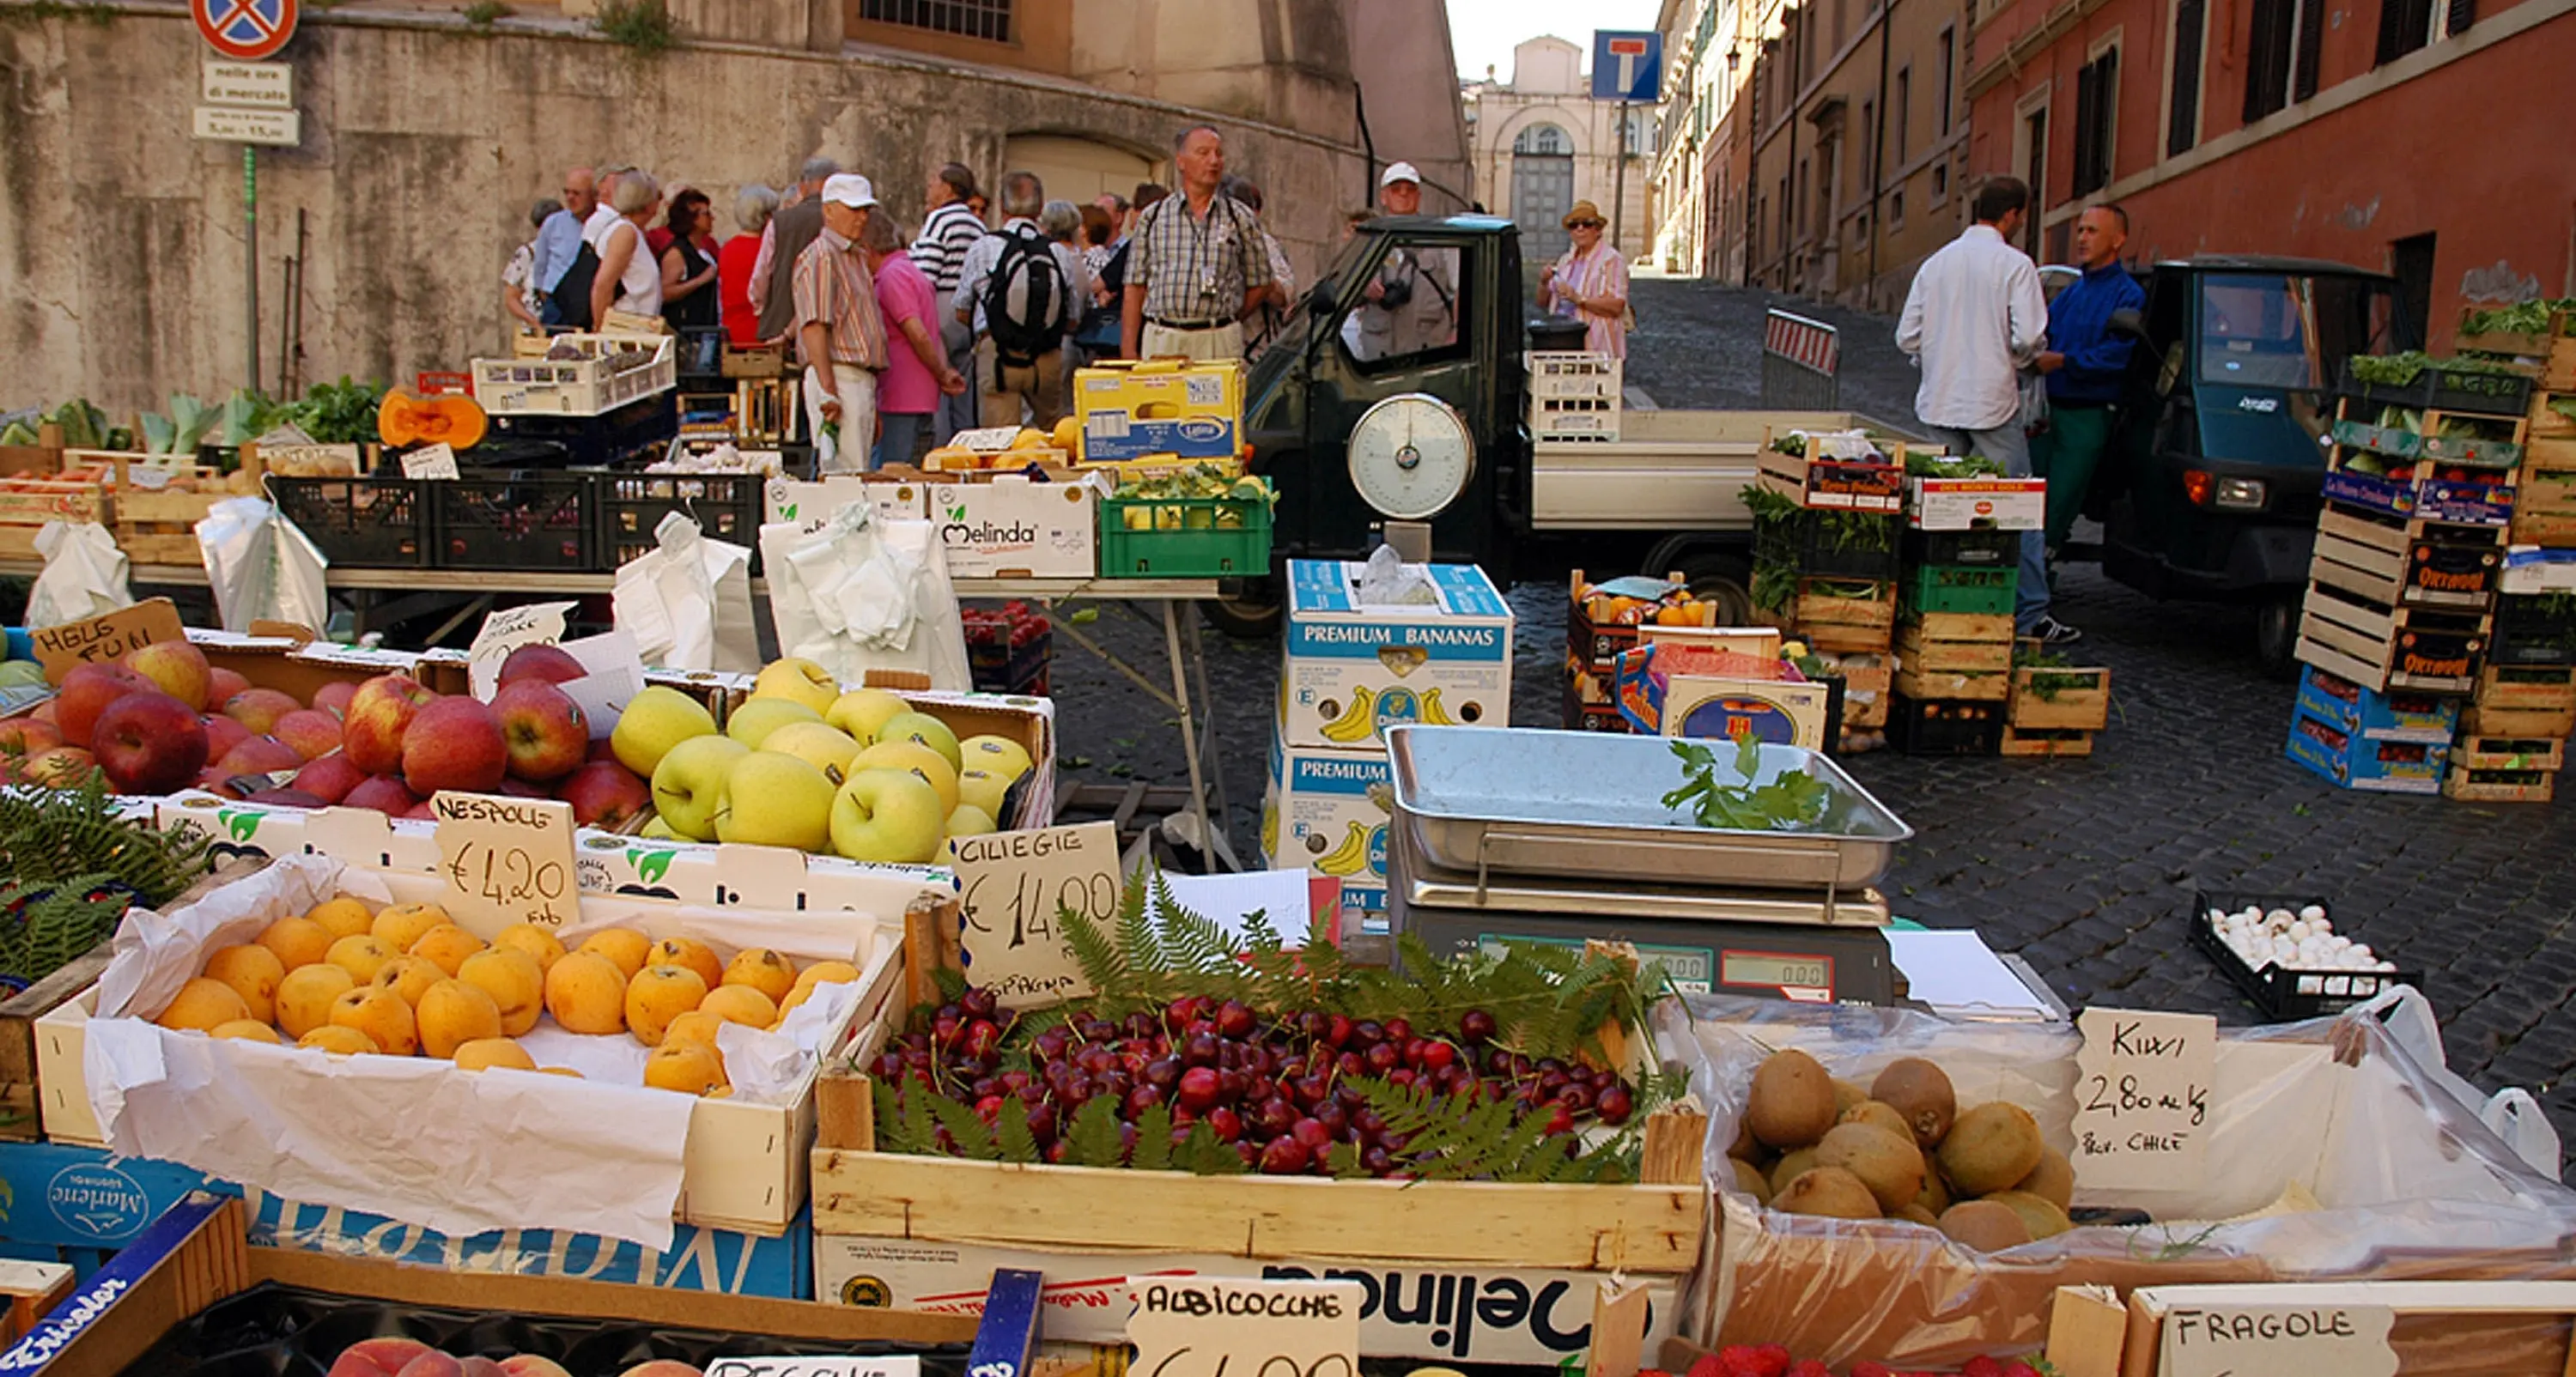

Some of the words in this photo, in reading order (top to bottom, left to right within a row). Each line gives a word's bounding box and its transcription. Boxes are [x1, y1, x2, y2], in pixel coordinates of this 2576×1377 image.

[942, 520, 1036, 543] Melinda
[1303, 625, 1392, 644] PREMIUM
[1406, 628, 1496, 647] BANANAS
[1301, 761, 1388, 781] PREMIUM
[959, 830, 1083, 864] CILIEGIE
[981, 973, 1076, 998] SPAGNA
[52, 1187, 142, 1214] Marlene
[1146, 1284, 1343, 1319] ALBICOCCHE
[2172, 1310, 2355, 1345] FRAGOLE
